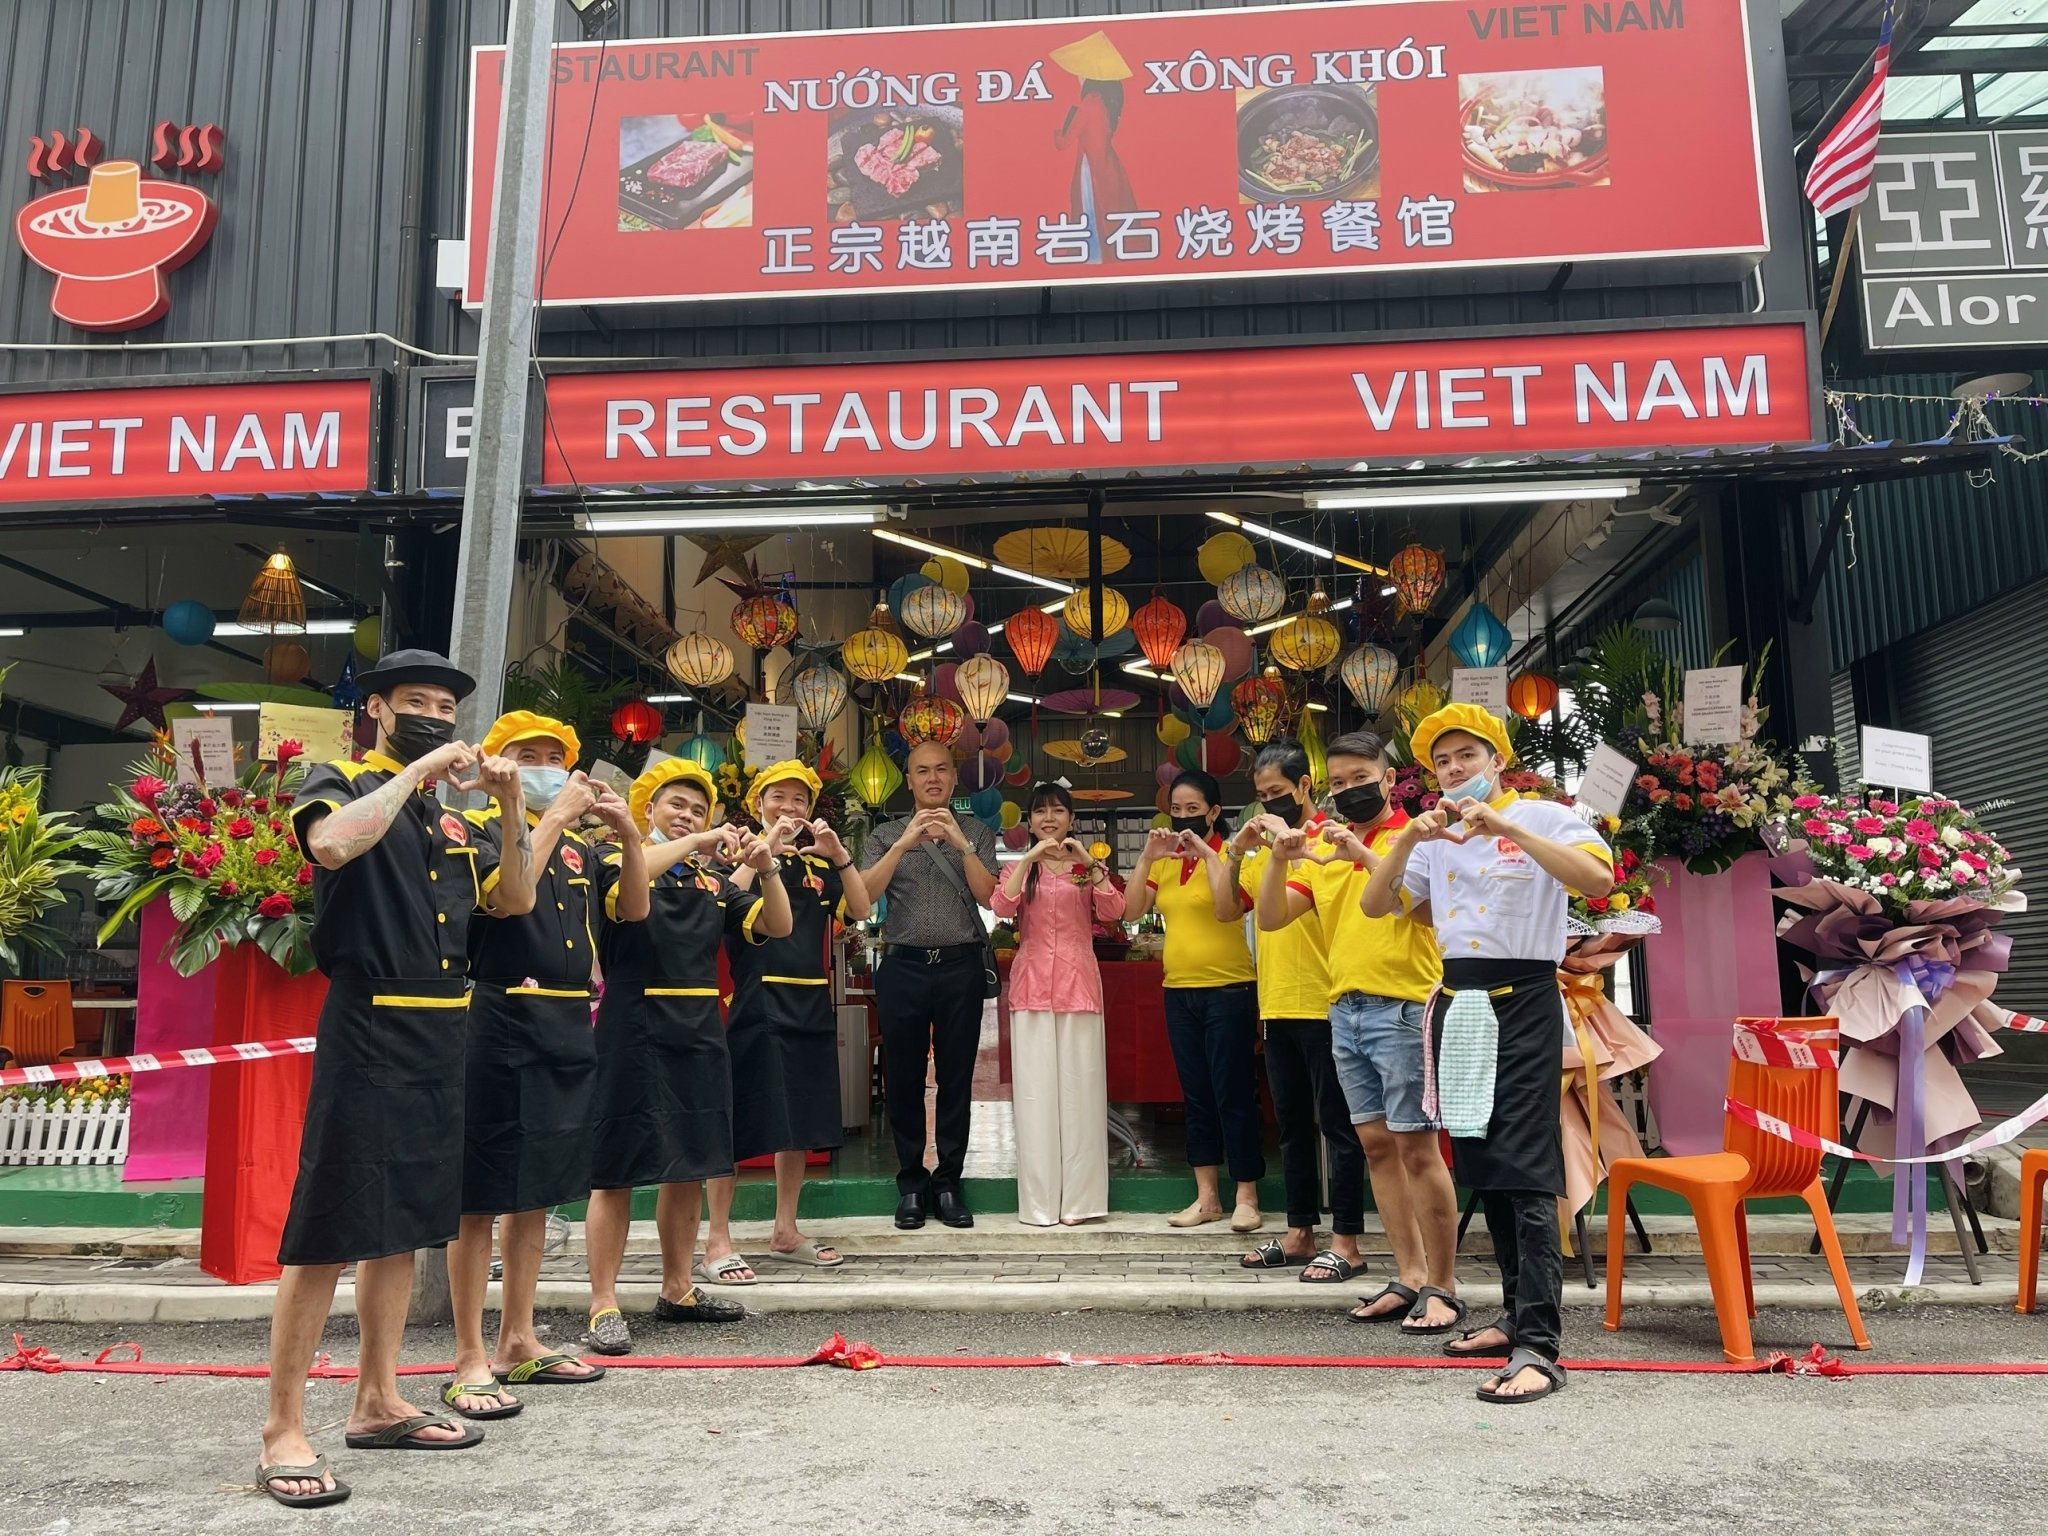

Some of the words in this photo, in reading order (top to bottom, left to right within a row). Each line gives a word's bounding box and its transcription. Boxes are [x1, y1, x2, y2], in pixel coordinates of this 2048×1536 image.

[1467, 4, 1567, 41] VIET
[1583, 0, 1684, 34] NAM
[499, 48, 760, 86] STAURANT
[764, 66, 961, 113] NƯỚNG
[977, 60, 1053, 103] ĐÁ
[1144, 49, 1295, 95] XÔNG
[1312, 37, 1448, 86] KHÓI
[761, 195, 1456, 274] 正宗越南岩石烧烤餐馆
[1884, 283, 2037, 328] Alor
[605, 380, 1179, 460] RESTAURANT
[1352, 364, 1543, 432] VIET
[1574, 354, 1769, 424] NAM
[168, 411, 341, 474] NAM
